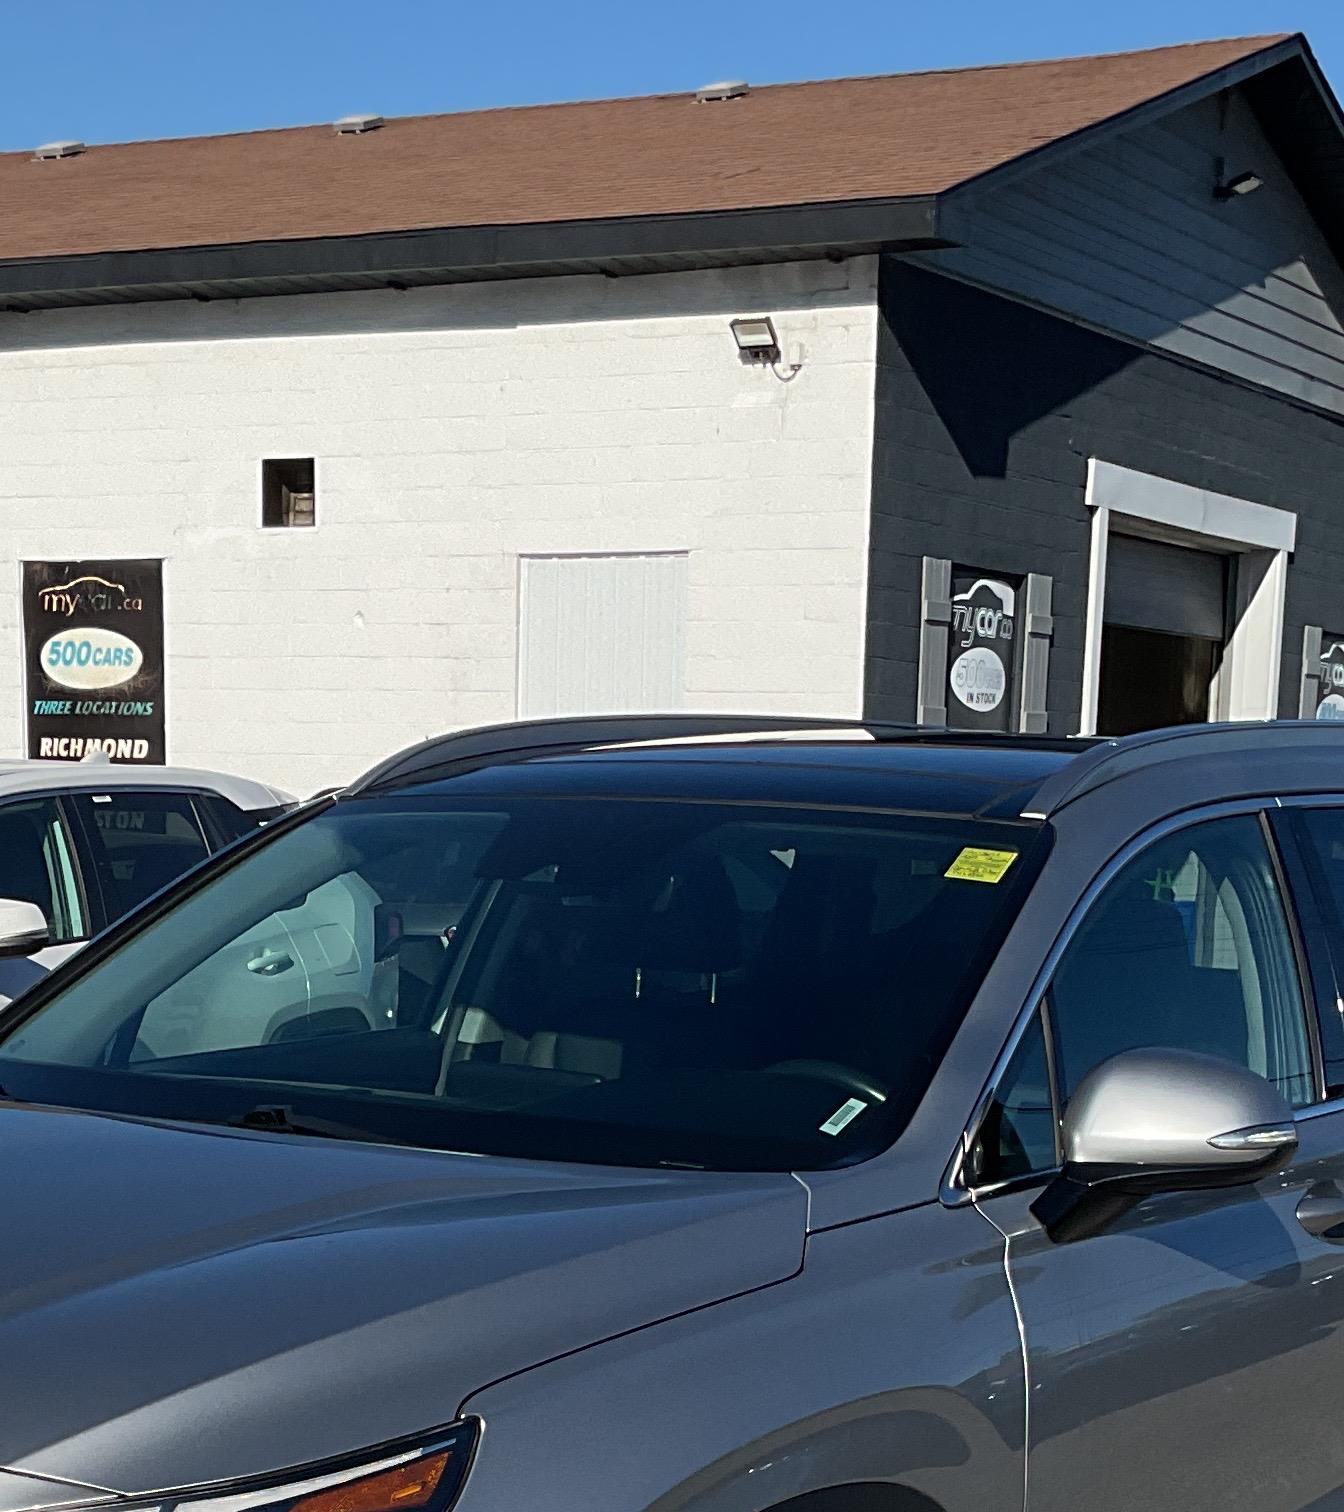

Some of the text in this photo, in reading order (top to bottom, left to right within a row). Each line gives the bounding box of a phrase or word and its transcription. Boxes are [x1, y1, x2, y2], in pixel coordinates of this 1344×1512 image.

[47, 640, 134, 667] 500 CARS
[33, 700, 154, 716] THREE LOCATIONS
[40, 737, 149, 759] RICHMOND
